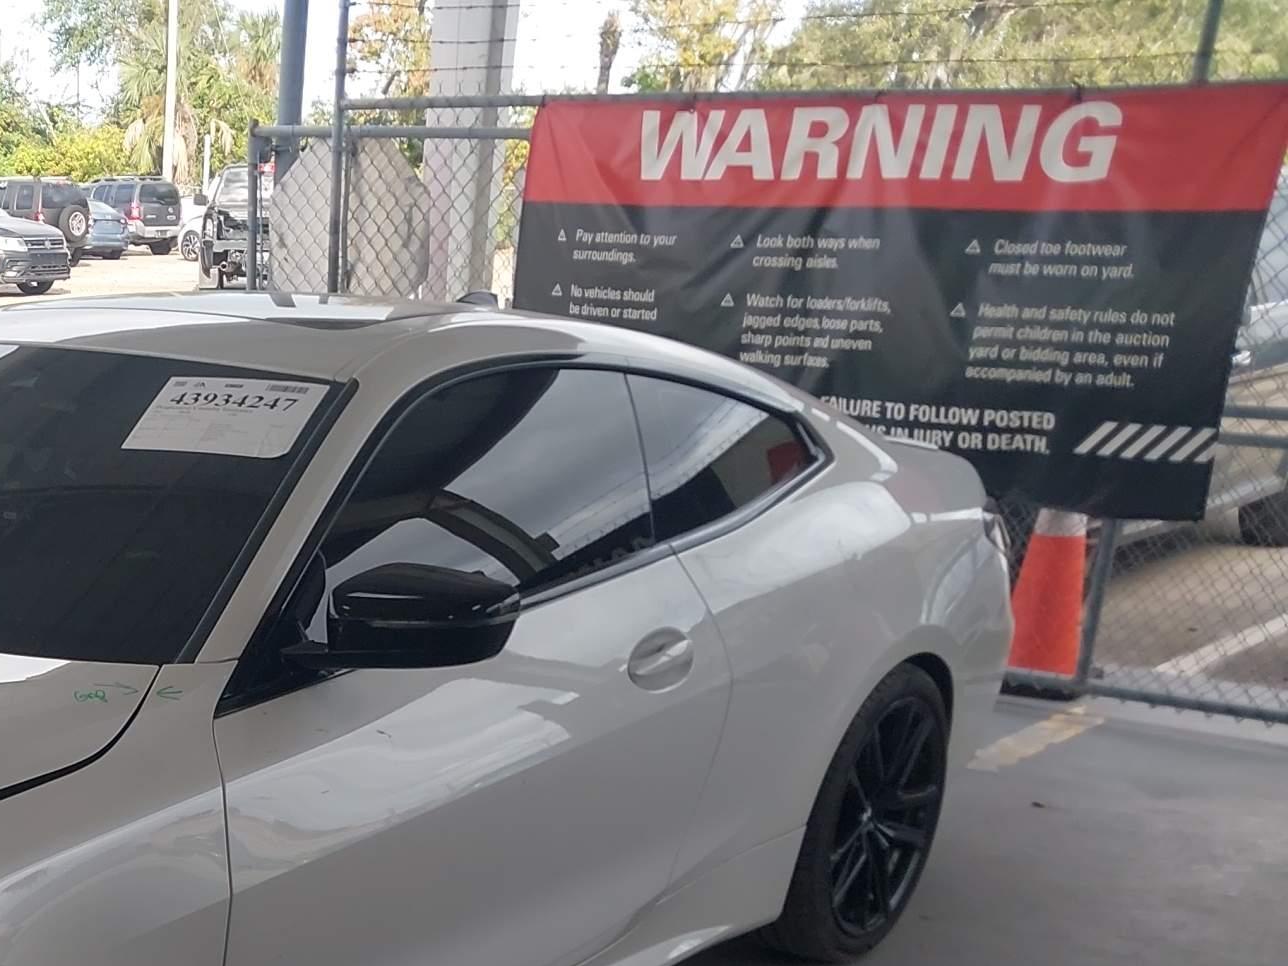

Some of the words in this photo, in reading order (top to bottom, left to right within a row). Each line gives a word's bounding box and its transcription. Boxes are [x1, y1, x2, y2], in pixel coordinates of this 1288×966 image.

[640, 101, 1123, 183] WARNING
[576, 228, 592, 245] Pay
[595, 231, 637, 244] attention
[640, 233, 651, 245] to
[653, 235, 677, 247] your
[757, 234, 783, 249] Look
[786, 234, 814, 249] both
[817, 236, 845, 251] ways
[848, 236, 880, 249] when
[573, 248, 636, 264] surroundings.
[994, 239, 1039, 255] Closed
[1040, 241, 1061, 255] toe
[1064, 240, 1127, 257] footwear
[752, 253, 803, 271] crossing
[988, 261, 1021, 275] must
[1024, 261, 1039, 276] be
[1043, 264, 1077, 277] worn
[1081, 265, 1098, 277] on
[1102, 264, 1134, 280] yard.
[571, 284, 582, 297] No
[584, 286, 621, 300] vehicles
[623, 288, 655, 302] should
[746, 293, 783, 308] Watch
[787, 294, 804, 309] for
[569, 302, 580, 315] be
[581, 303, 609, 317] driven
[611, 307, 620, 317] or
[623, 307, 657, 320] started
[978, 303, 1019, 318] Health
[1021, 304, 1046, 319] and
[1049, 306, 1091, 324] safety
[1093, 308, 1126, 323] rules
[1130, 309, 1148, 324] do
[1151, 311, 1176, 327] not
[742, 312, 781, 328] jagged
[822, 316, 847, 329] loose
[849, 319, 884, 334] parts,
[741, 331, 772, 347] sharp
[775, 333, 811, 348] points
[831, 337, 872, 350] uneven
[972, 325, 1014, 340] permit
[1016, 326, 1068, 342] children
[1072, 327, 1084, 342] in
[1088, 329, 1111, 344] the
[1115, 331, 1170, 348] auction
[740, 351, 781, 367] walking
[968, 345, 998, 361] yard
[1001, 348, 1016, 360] or
[1019, 346, 1069, 366] bidding
[1073, 352, 1109, 367] area,
[1113, 354, 1148, 367] even
[1153, 352, 1165, 368] if
[965, 366, 1052, 383] accompanied
[1055, 368, 1073, 386] by
[1075, 372, 1092, 384] an
[1096, 371, 1135, 387] adult.
[170, 391, 299, 412] 43934247
[885, 401, 905, 421] TO
[909, 403, 980, 425] FOLLOW
[983, 410, 1056, 430] POSTED
[957, 432, 984, 449] OR
[987, 433, 1050, 455] DEATH.
